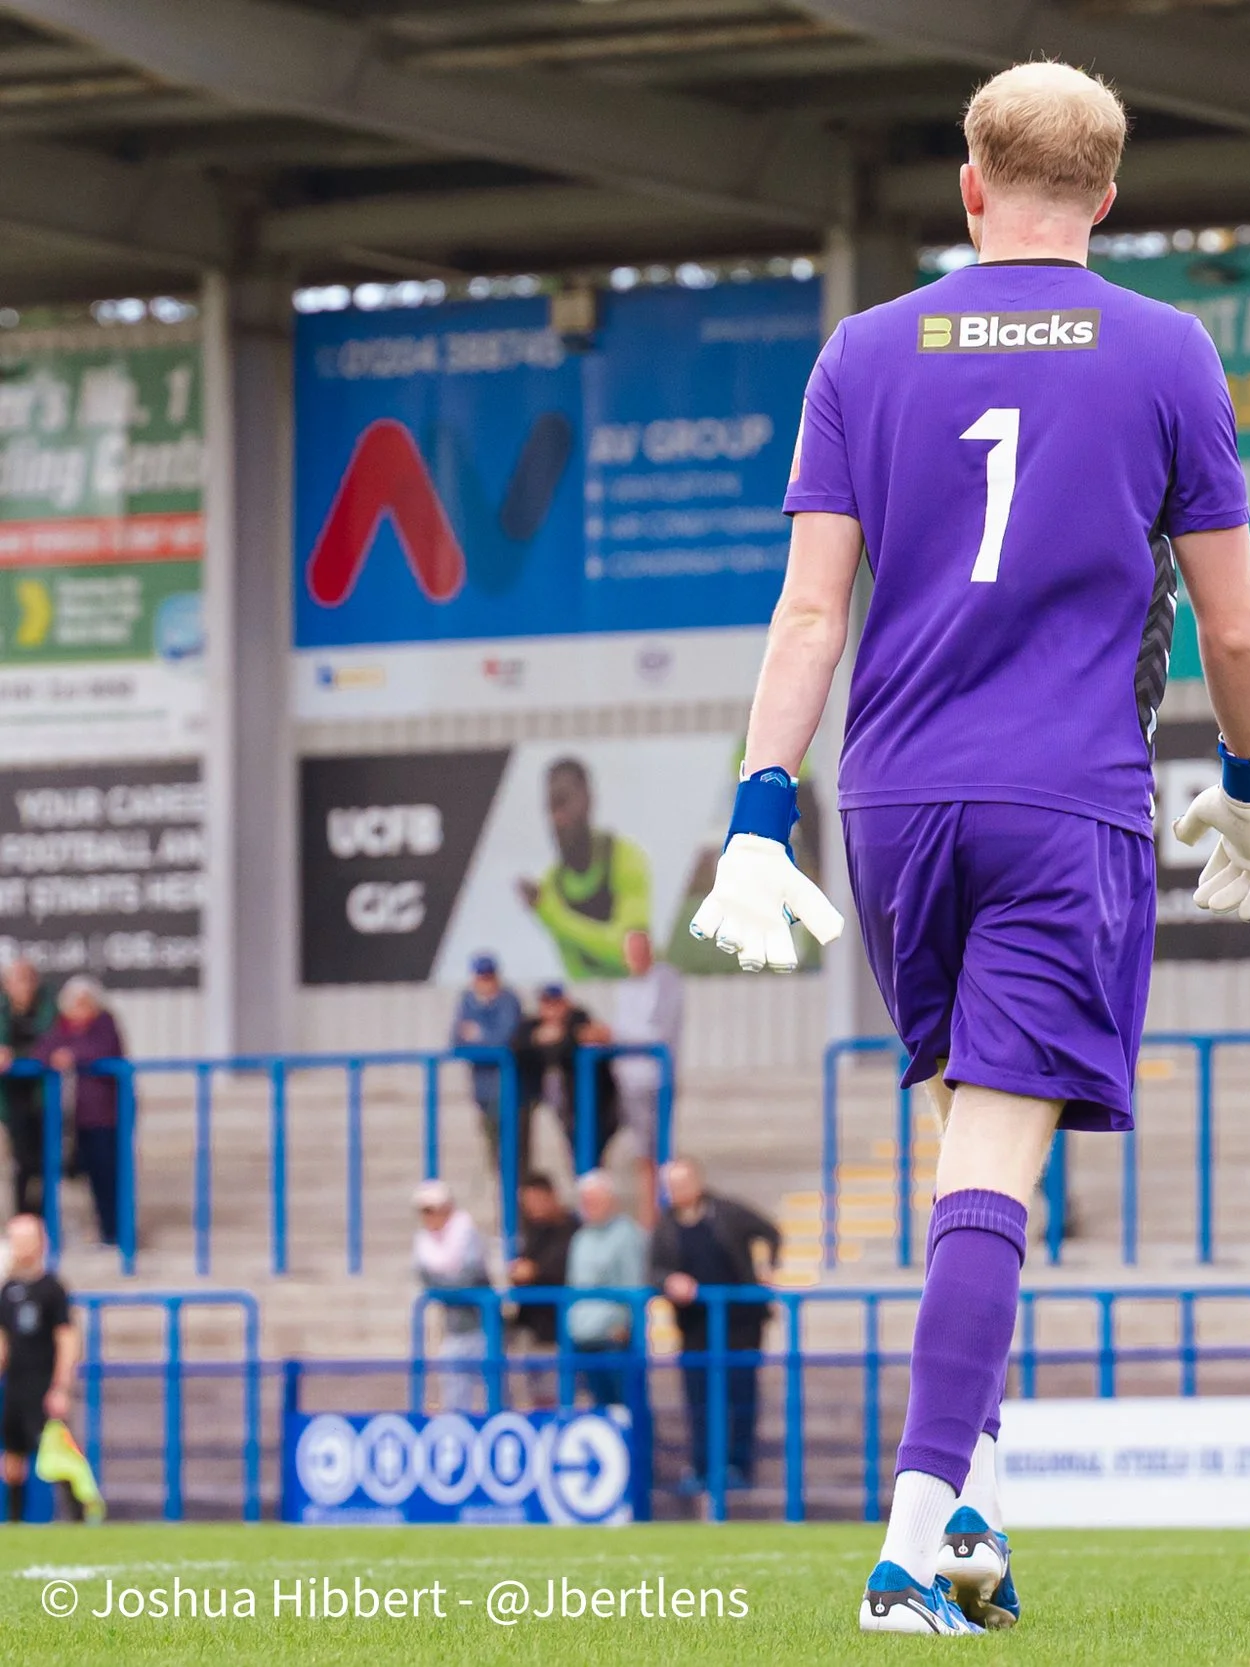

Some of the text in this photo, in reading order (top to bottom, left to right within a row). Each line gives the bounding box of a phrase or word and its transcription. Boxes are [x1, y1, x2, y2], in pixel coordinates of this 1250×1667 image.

[959, 315, 1094, 347] Blacks
[643, 414, 774, 464] GROUP
[959, 407, 1021, 583] 1
[327, 803, 445, 859] UCFB
